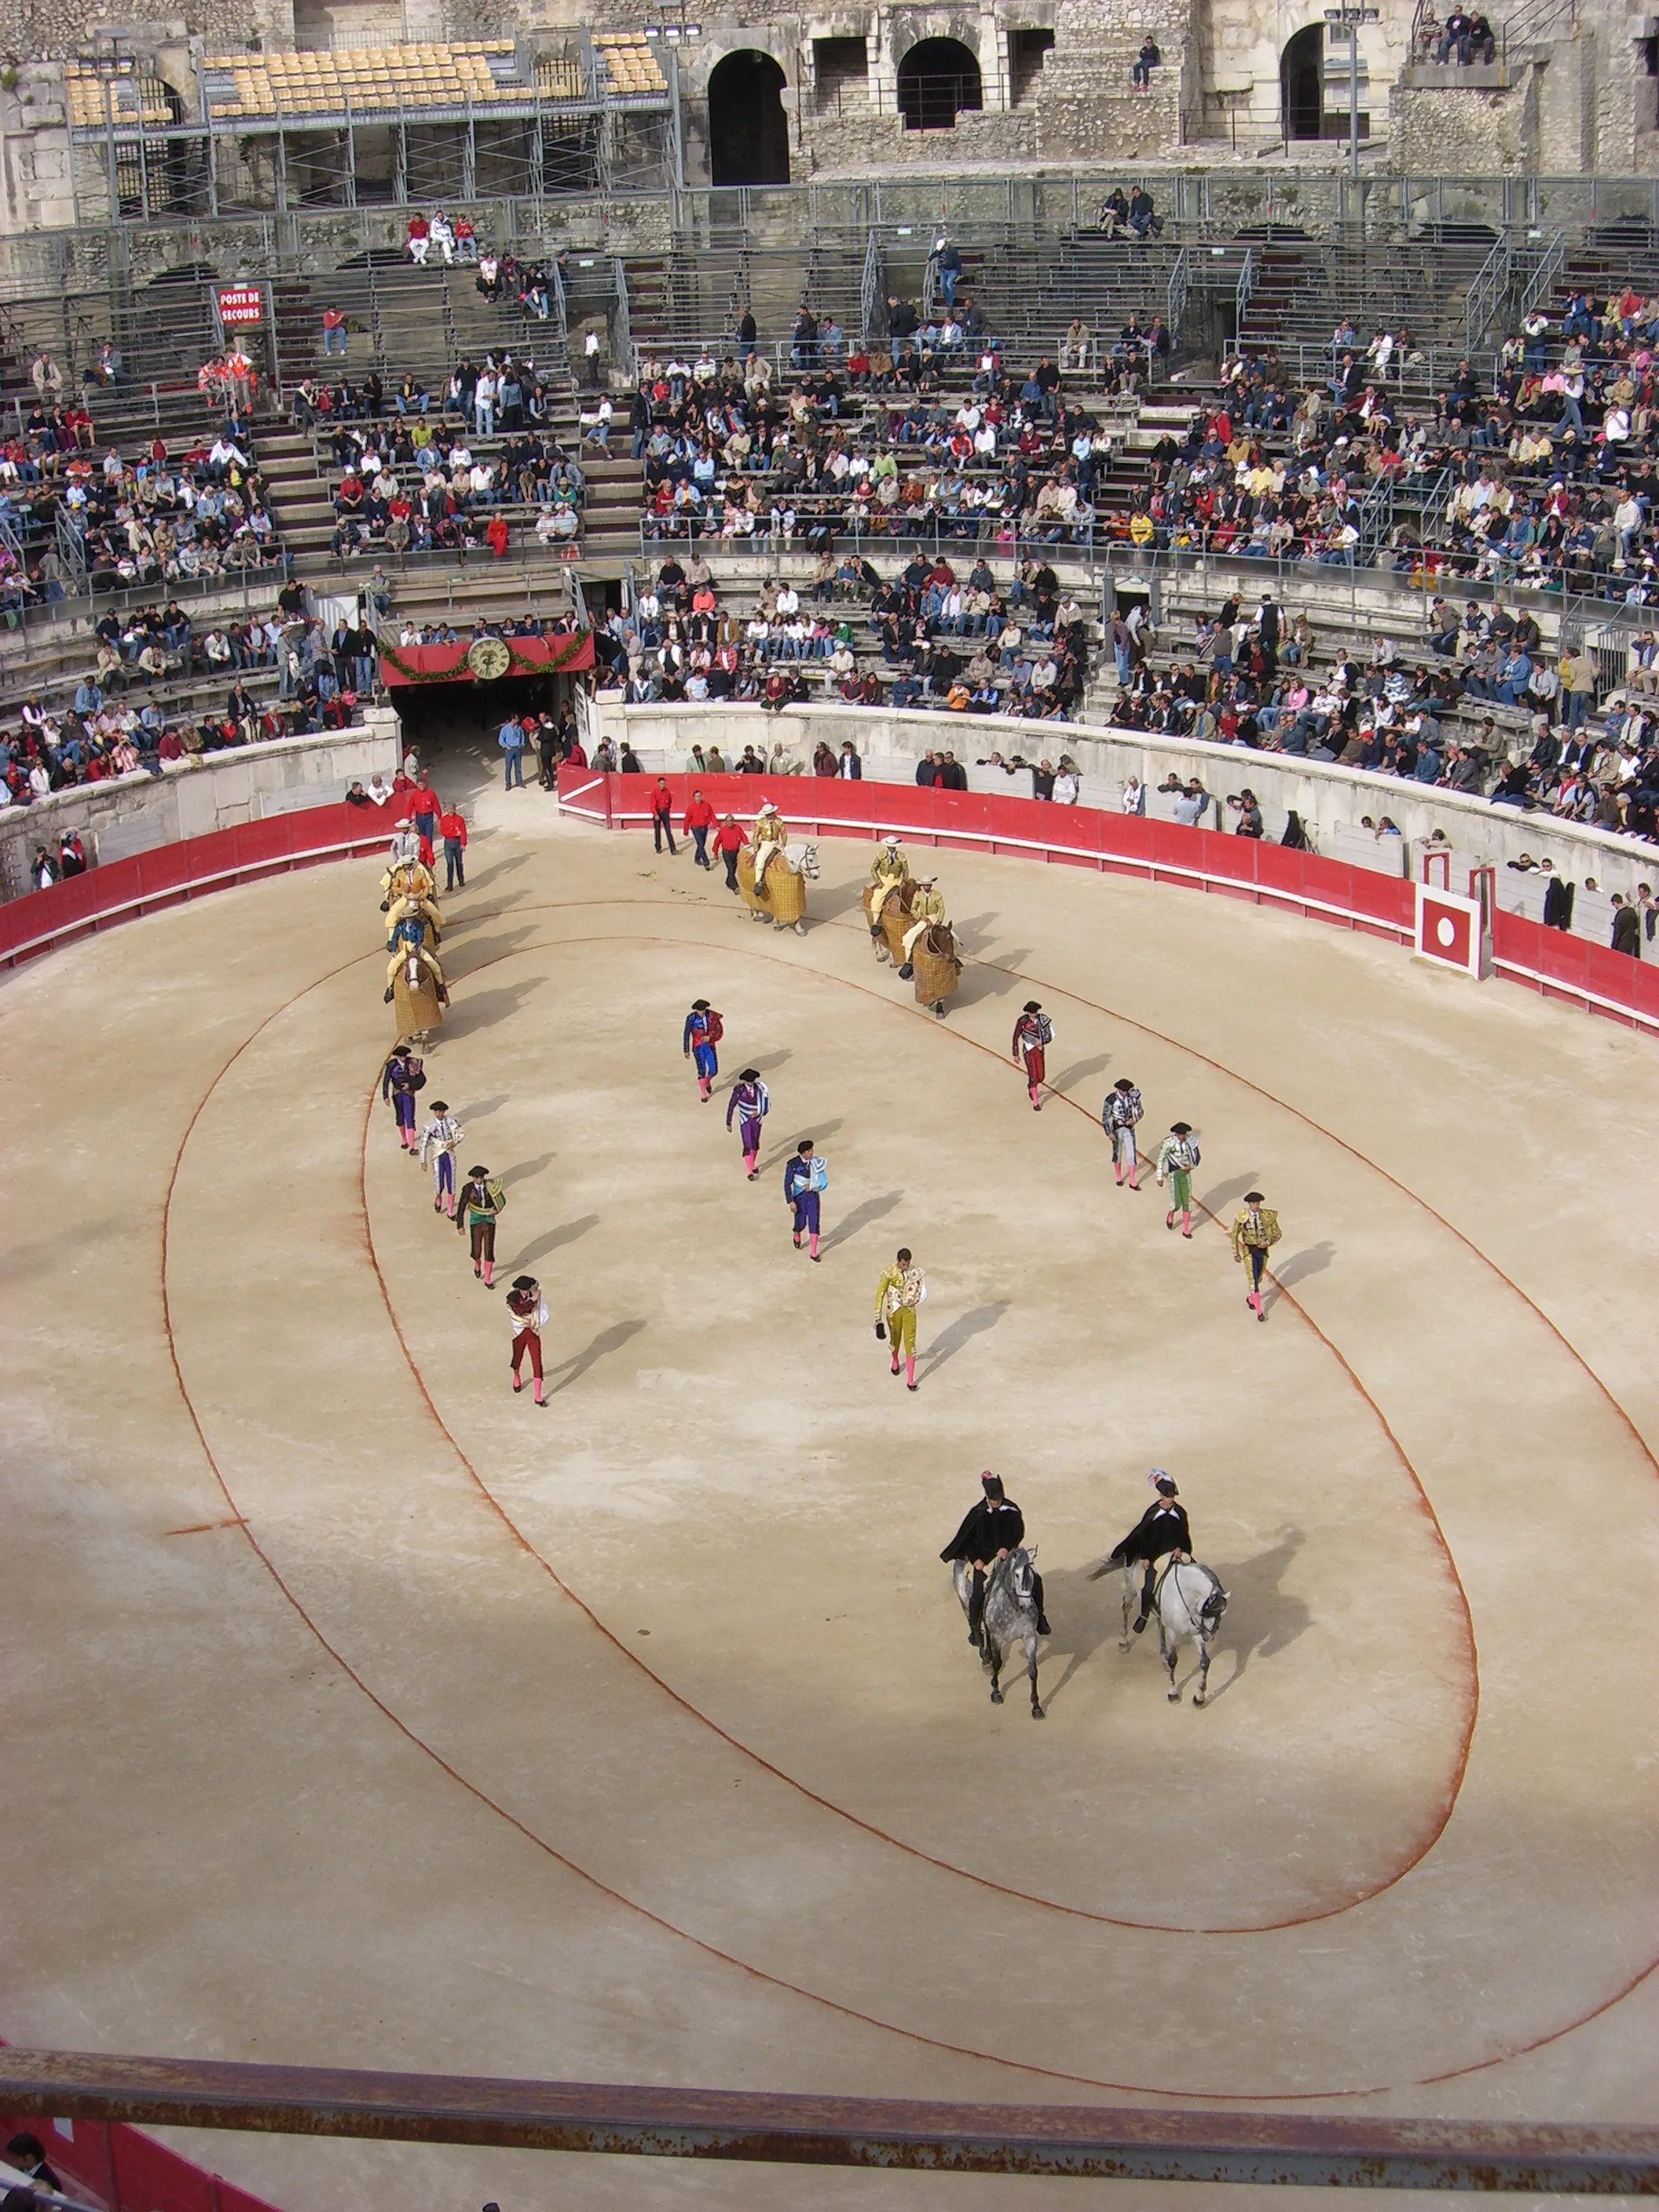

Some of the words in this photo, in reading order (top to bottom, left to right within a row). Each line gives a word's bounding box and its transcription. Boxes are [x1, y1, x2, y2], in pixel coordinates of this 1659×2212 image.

[220, 293, 247, 305] POSTE
[248, 291, 259, 303] DE
[222, 307, 259, 320] SECOURS
